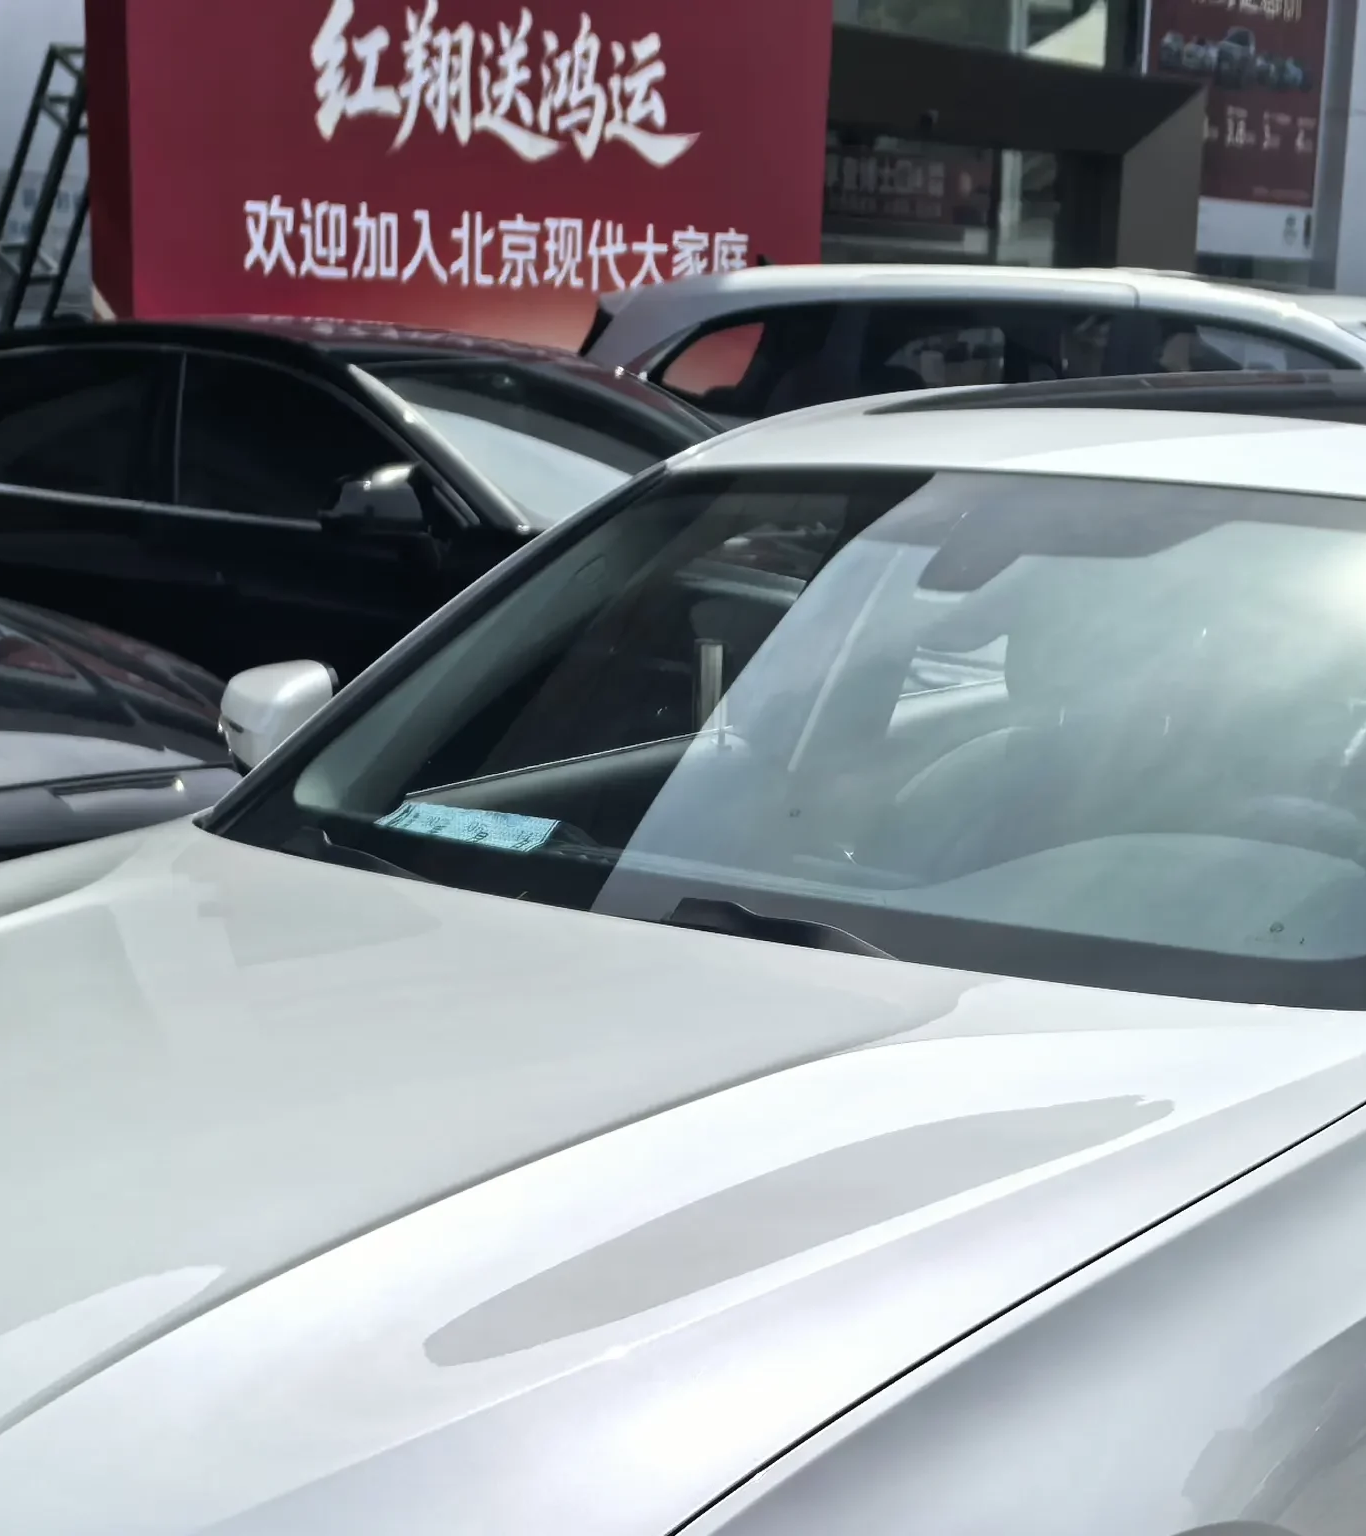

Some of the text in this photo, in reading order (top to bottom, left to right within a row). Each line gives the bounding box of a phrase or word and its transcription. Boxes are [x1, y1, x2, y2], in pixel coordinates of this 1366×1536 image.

[310, 0, 703, 168] 红翔送鸿运
[243, 196, 750, 291] 欢迎加入北京现代大家庭
